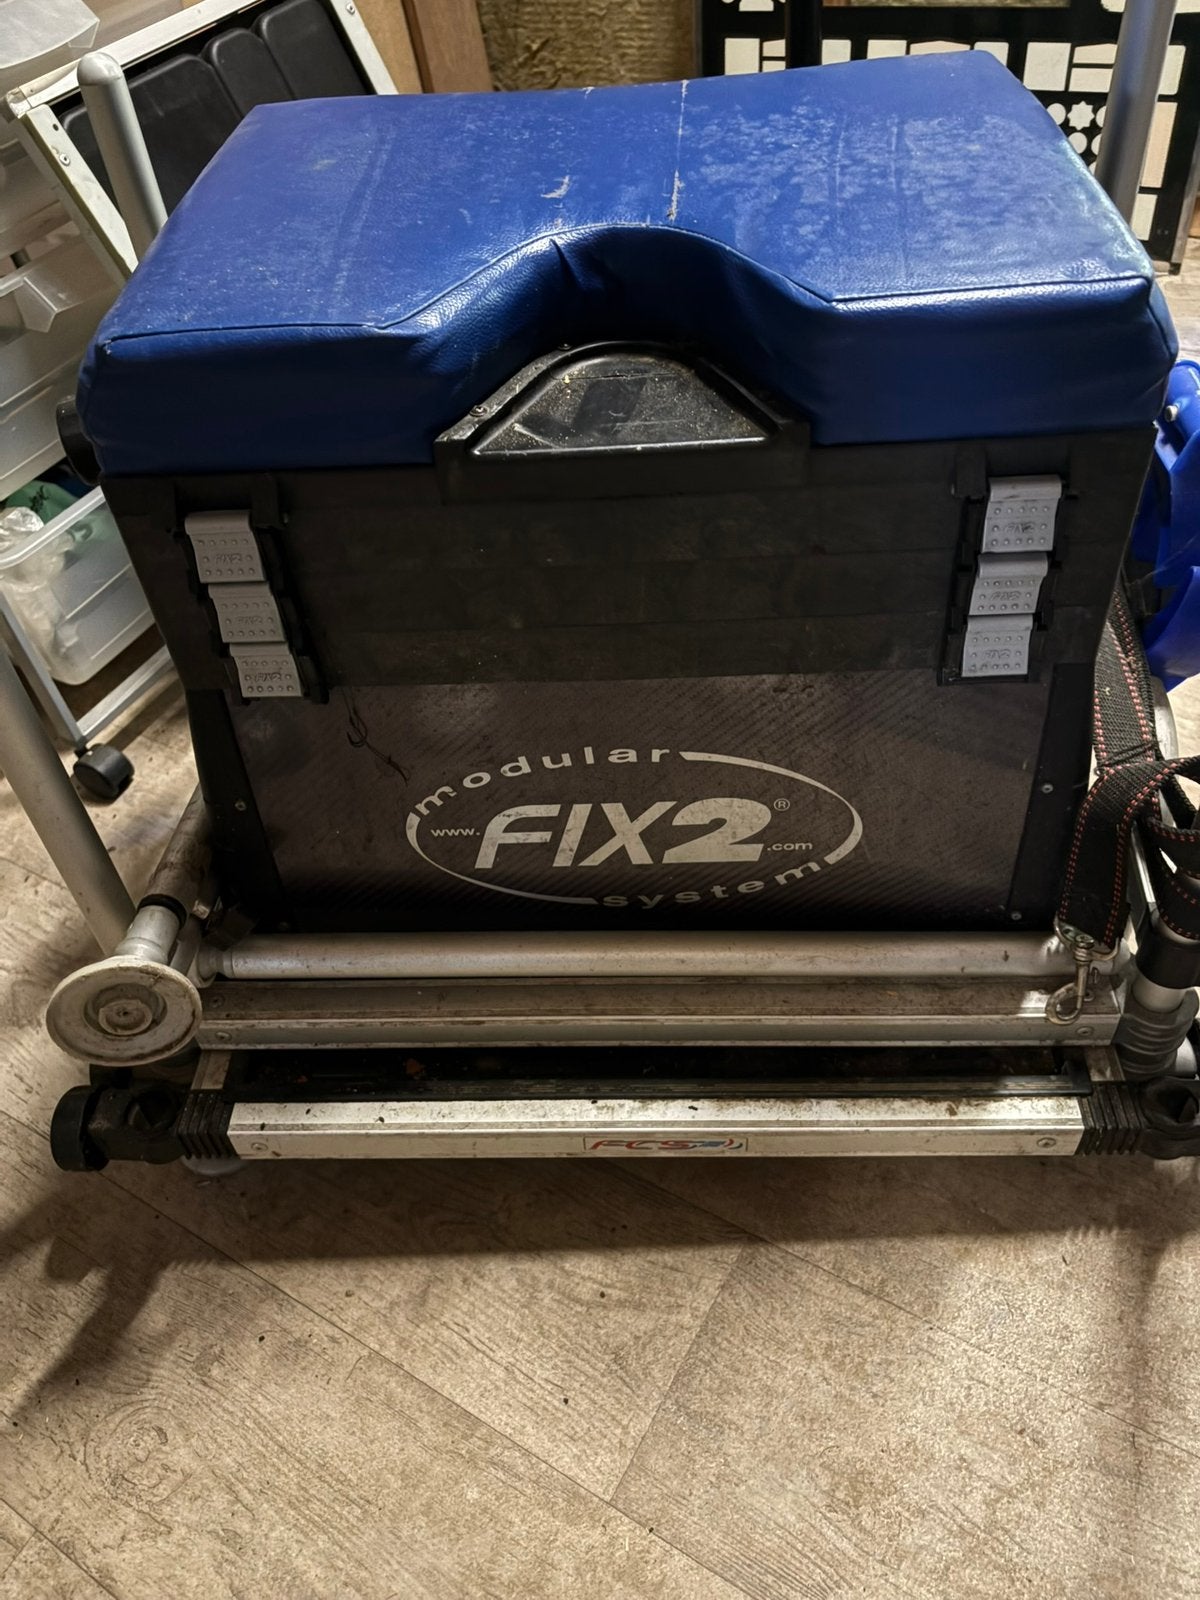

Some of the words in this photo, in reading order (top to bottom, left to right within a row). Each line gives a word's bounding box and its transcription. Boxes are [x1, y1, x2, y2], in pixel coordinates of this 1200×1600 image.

[414, 746, 670, 817] modular
[430, 826, 480, 837] www.
[474, 797, 772, 869] FIX2
[767, 839, 813, 852] .com
[600, 859, 822, 909] system
